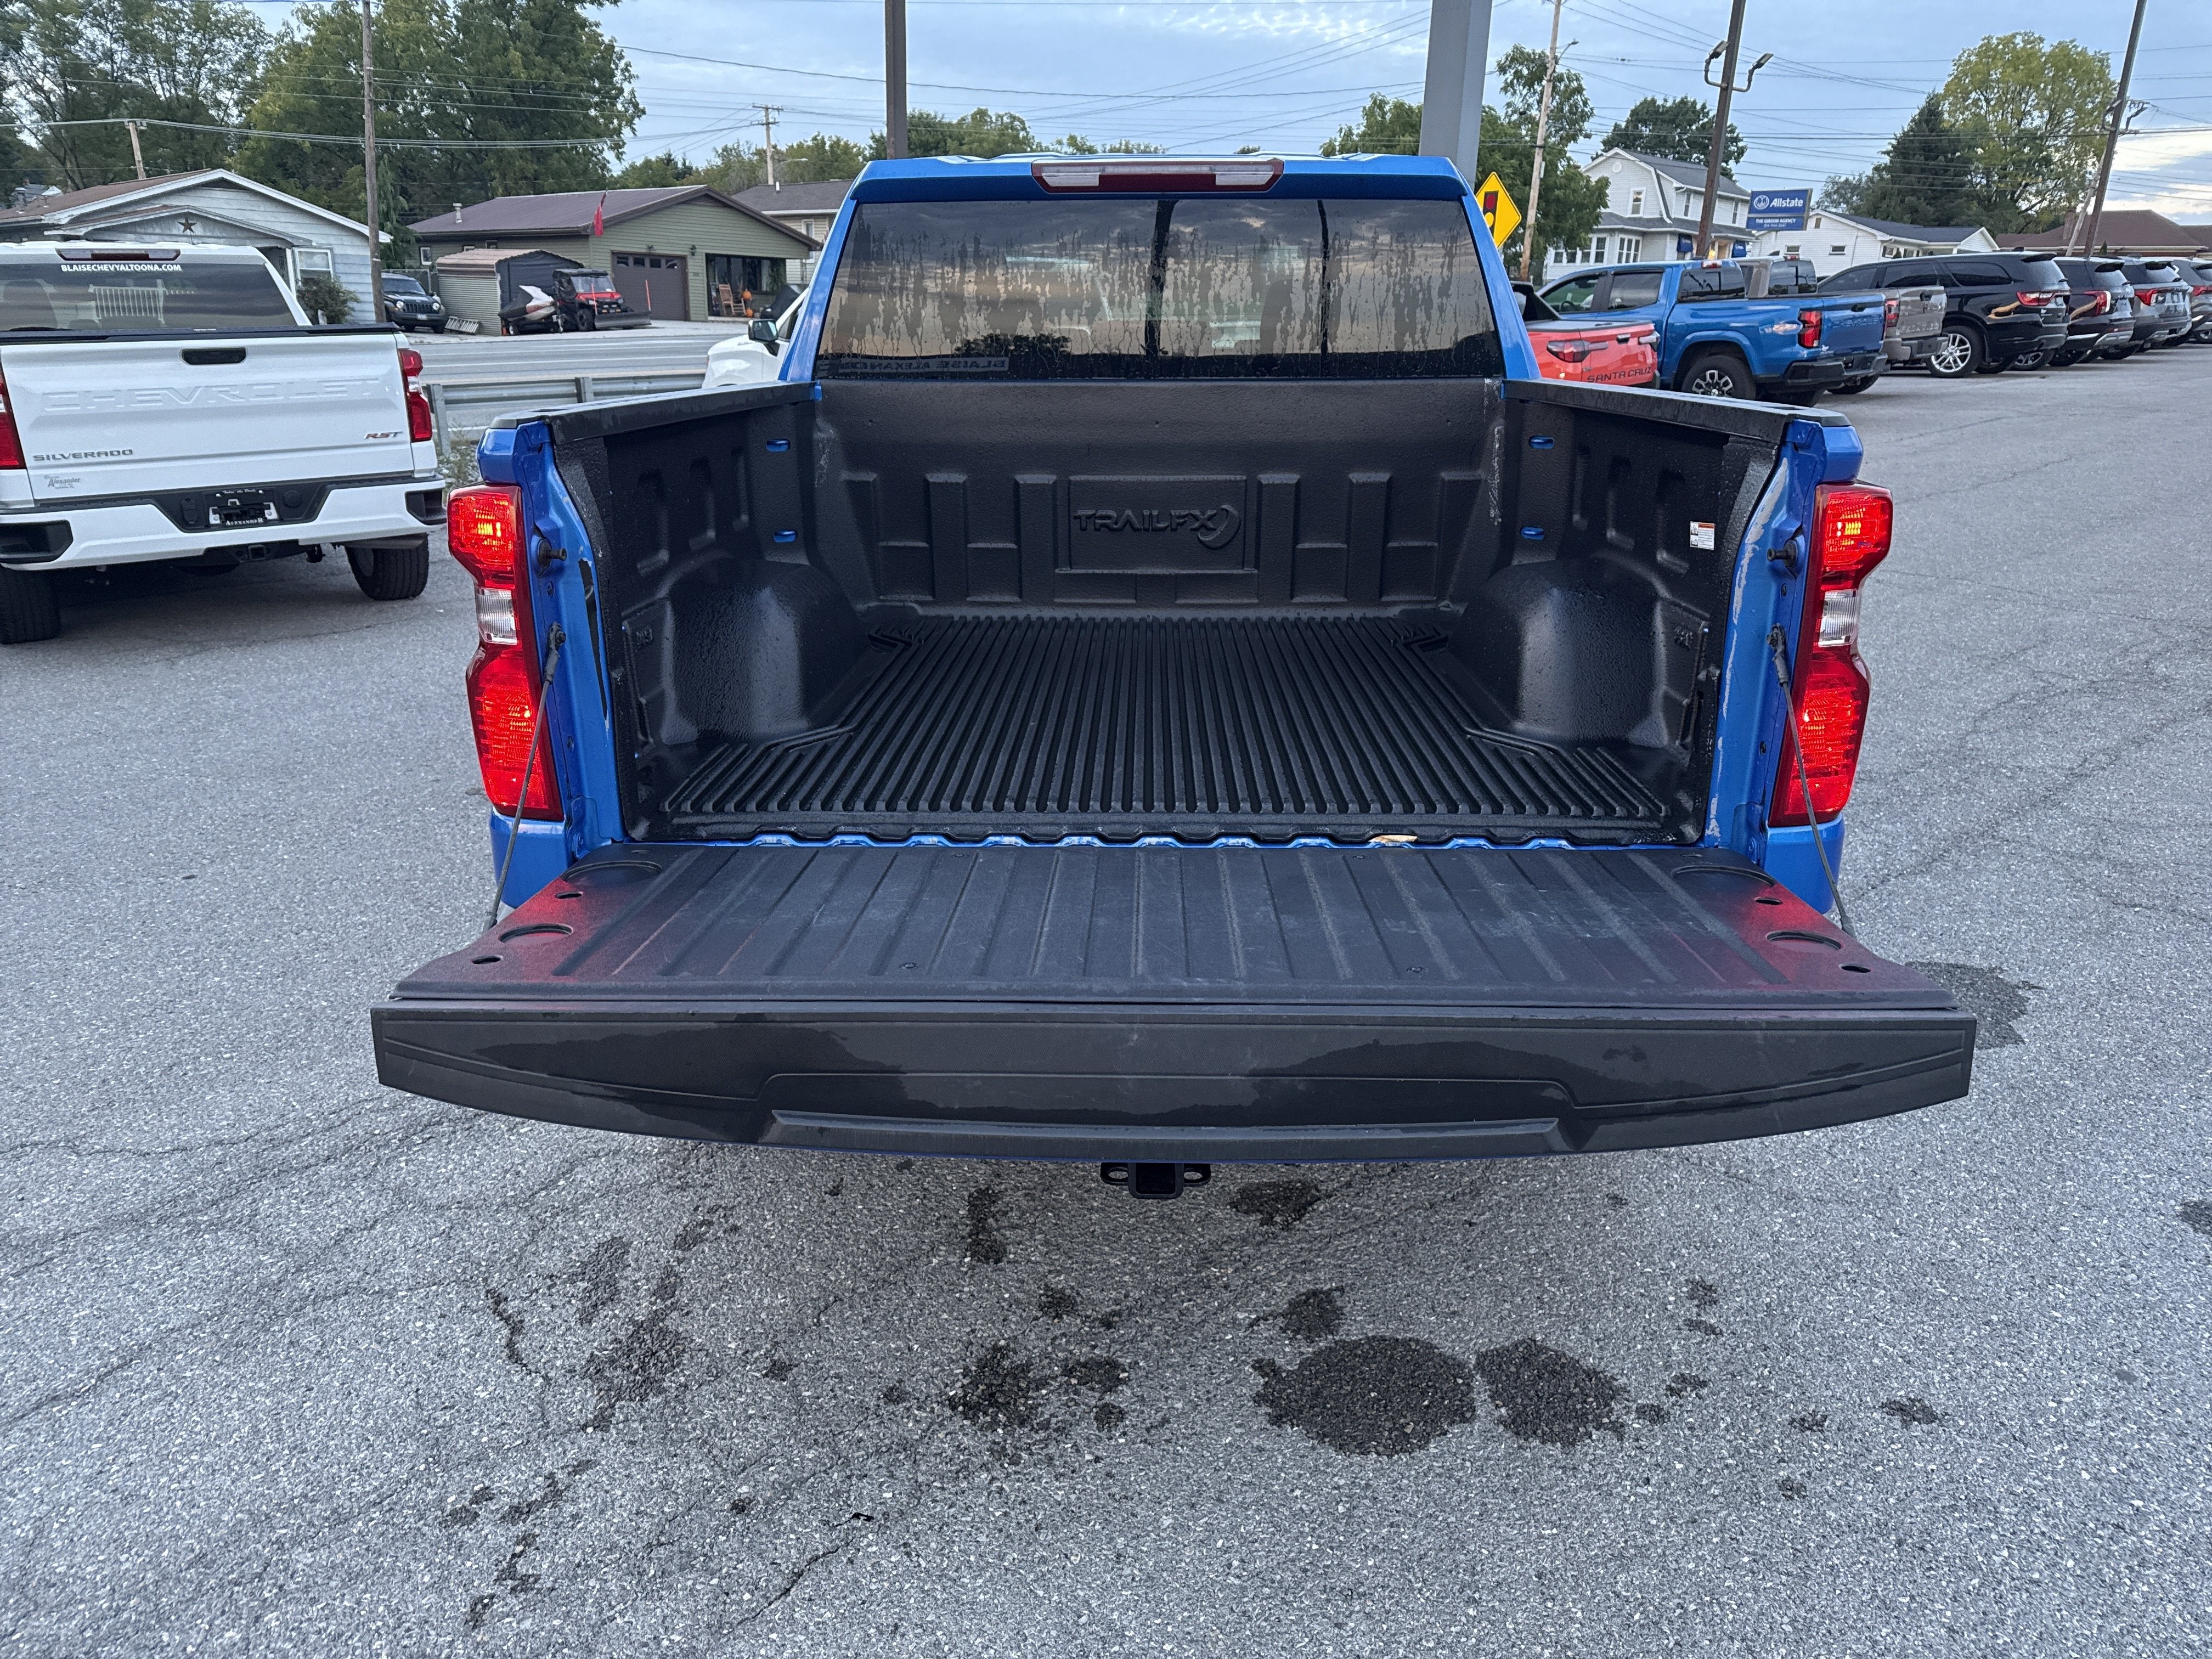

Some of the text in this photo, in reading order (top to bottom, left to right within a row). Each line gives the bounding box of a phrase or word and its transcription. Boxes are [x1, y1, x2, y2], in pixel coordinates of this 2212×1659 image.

[1769, 197, 1803, 207] Allstate
[1587, 366, 1652, 383] SANTA CRUZ
[41, 377, 380, 411] CHEVROLET
[363, 431, 403, 439] RST
[33, 449, 133, 461] SILVERADO
[47, 477, 81, 487] Alexander
[225, 517, 264, 526] ALEXANDER
[1074, 510, 1218, 532] TRAILFX
